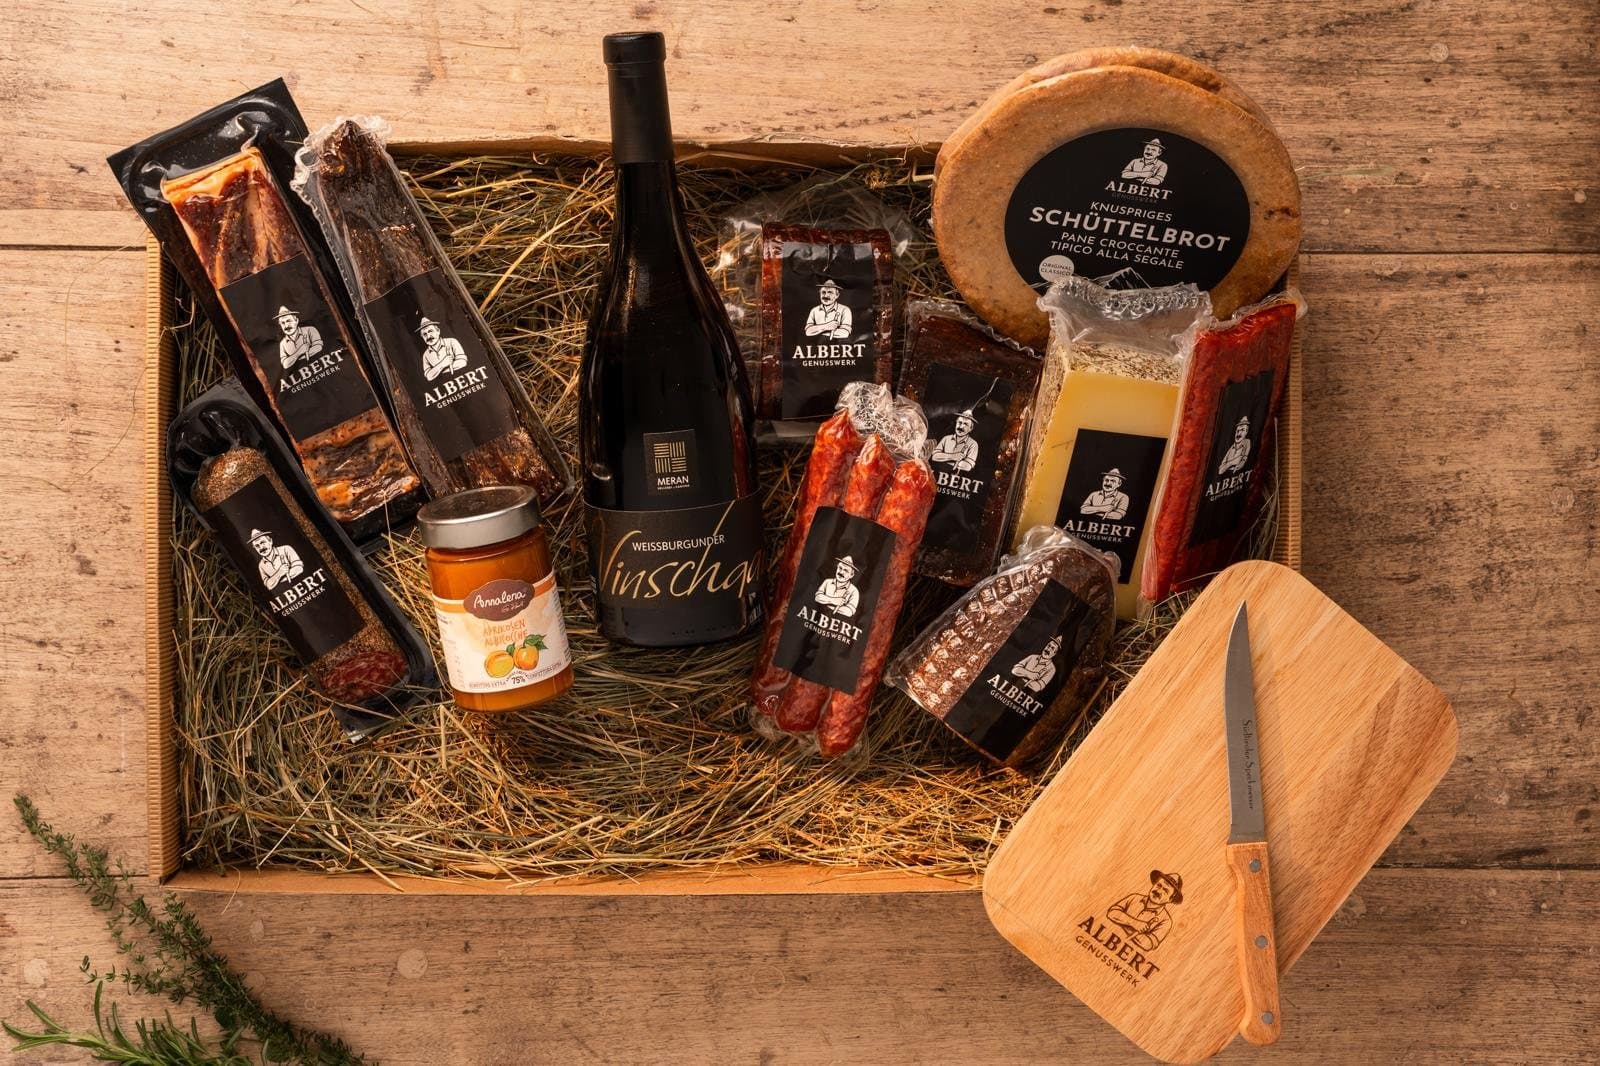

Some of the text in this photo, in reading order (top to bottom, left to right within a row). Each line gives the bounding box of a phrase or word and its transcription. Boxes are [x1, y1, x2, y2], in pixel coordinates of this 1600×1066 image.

[1105, 180, 1172, 200] ALBERT
[1090, 201, 1173, 222] KNUSPRIGES
[1029, 206, 1231, 251] SCHÜTTELBROT
[1050, 240, 1184, 270] TIPICO ALLA SEGALE
[1061, 231, 1179, 258] PANE CROCCANTE
[792, 344, 866, 359] ALBERT
[802, 359, 857, 367] GENUSSWERK
[279, 349, 344, 393] ALBERT
[291, 365, 341, 394] GENUSSWERK
[424, 366, 490, 407] ALBERT
[437, 383, 486, 409] GENUSSWERK
[657, 475, 689, 487] MERAN
[931, 470, 984, 494] BERT
[1205, 470, 1253, 497] ALBERT
[1063, 519, 1135, 537] ALBERT
[632, 534, 726, 552] WEISSBURGUNDER
[270, 568, 327, 614] ALBERT
[281, 587, 325, 617] GENUSSWERK
[473, 590, 527, 609] Annalena
[797, 605, 863, 641] ALBERT
[804, 621, 851, 645] GENUSSWERK
[511, 675, 526, 685] 75%
[987, 674, 1044, 715] ALBERT
[990, 690, 1028, 718] GENUSSWERK
[1076, 935, 1141, 988] GENUSSWERK
[1077, 916, 1160, 980] ALBERT
